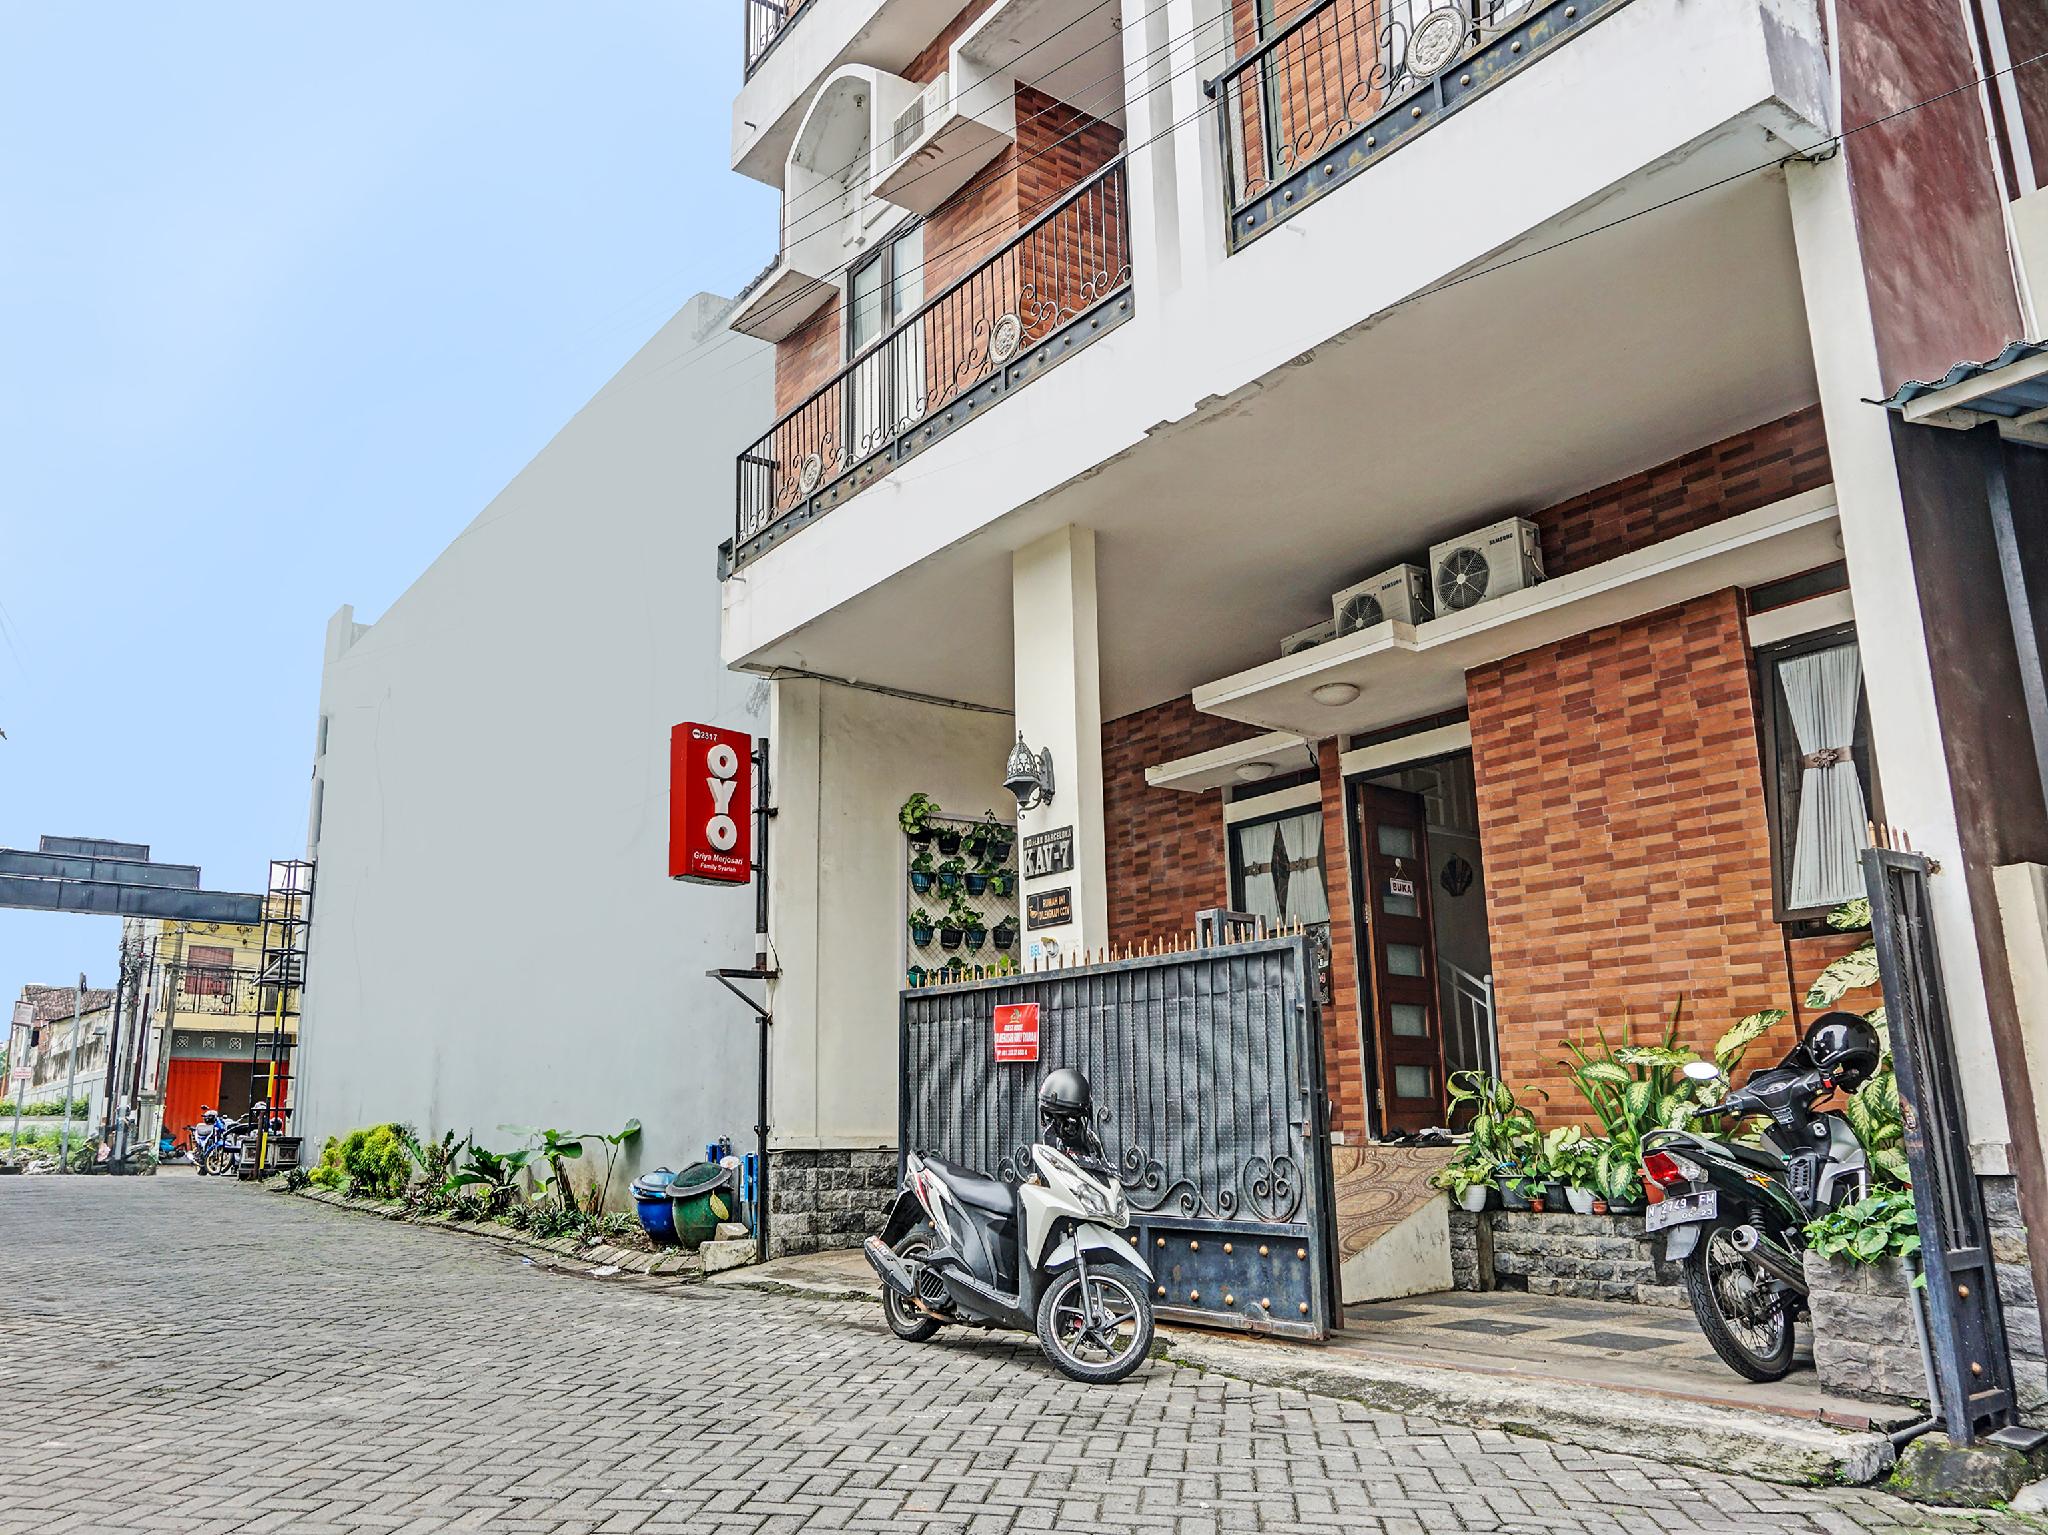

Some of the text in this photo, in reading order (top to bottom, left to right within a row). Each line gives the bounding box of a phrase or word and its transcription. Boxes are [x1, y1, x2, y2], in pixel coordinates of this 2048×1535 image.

[705, 743, 738, 851] OYO
[693, 851, 712, 862] Griya
[1024, 840, 1070, 877] KAV-7
[700, 862, 717, 871] Family
[1392, 882, 1412, 894] BUKA
[1648, 1207, 1655, 1218] N
[1698, 1193, 1715, 1206] FM
